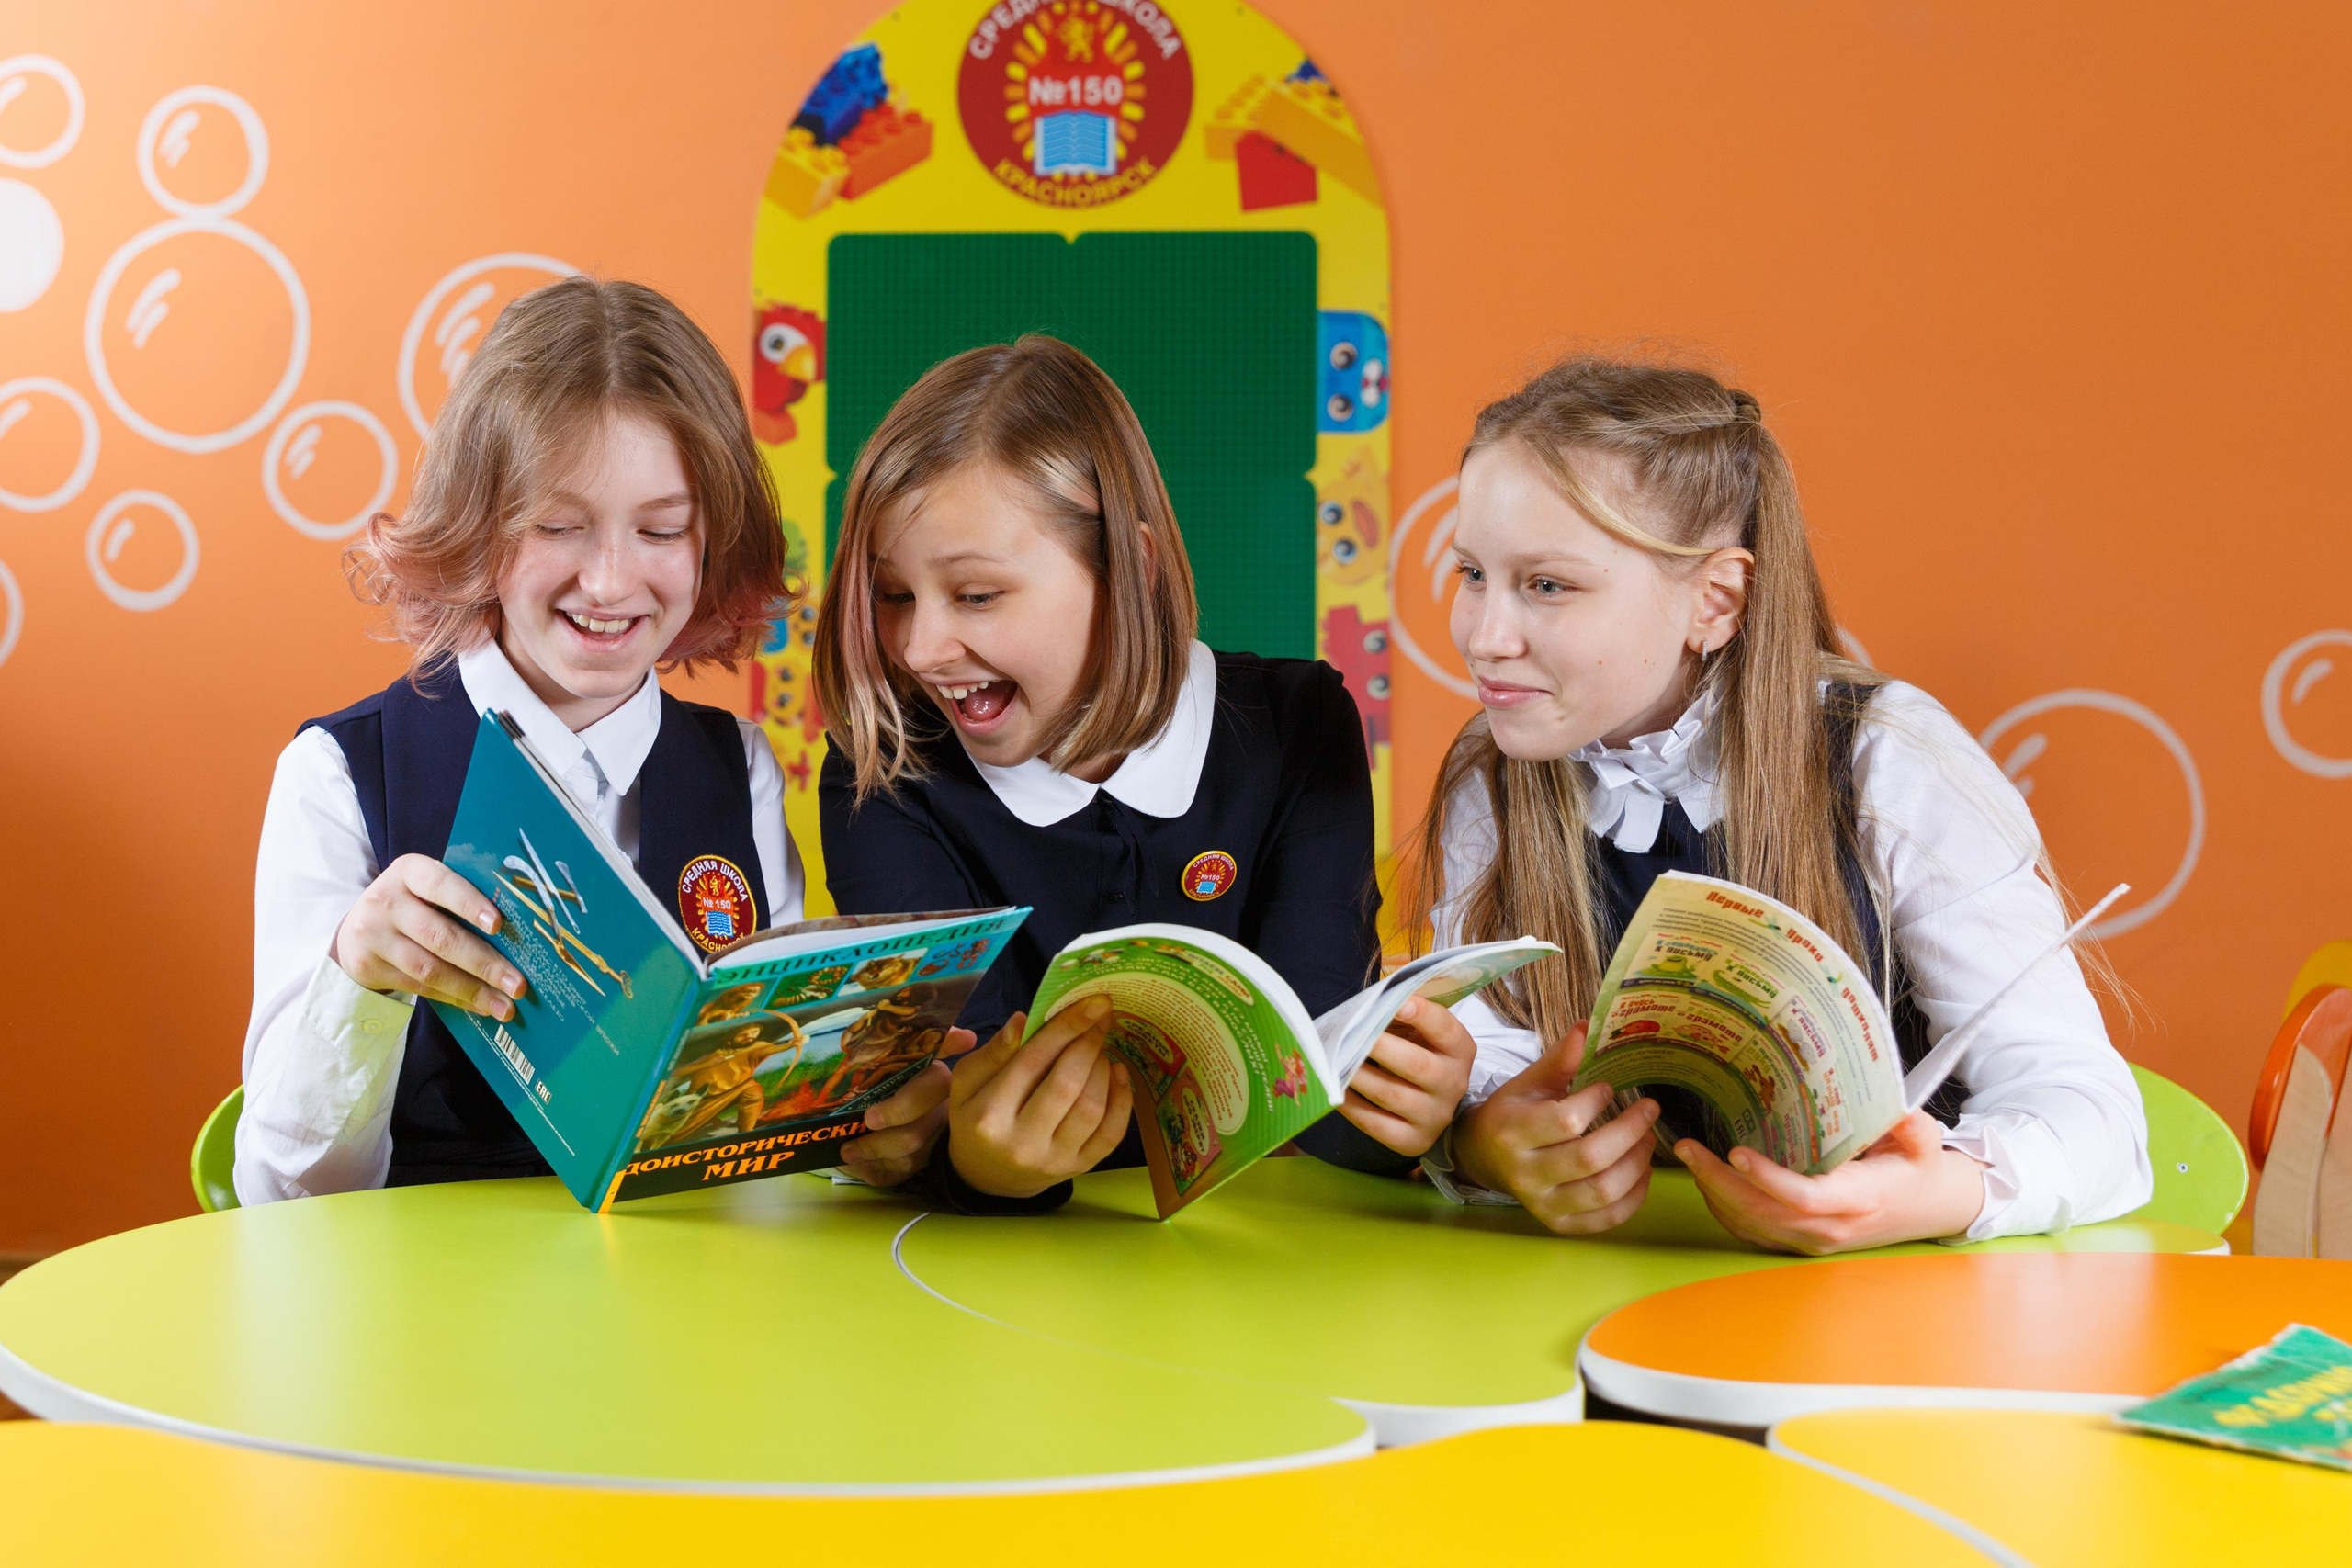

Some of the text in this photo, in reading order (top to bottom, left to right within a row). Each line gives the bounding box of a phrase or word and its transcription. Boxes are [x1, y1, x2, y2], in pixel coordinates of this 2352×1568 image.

[1027, 75, 1124, 106] №150
[994, 155, 1156, 209] КРАСНОЯРСК
[683, 860, 749, 902] СРЕДНЯЯ ШКОЛА
[716, 899, 731, 909] 150
[1706, 891, 1765, 919] Первые
[496, 931, 537, 986] РАГОЦЕННОЕ
[723, 919, 1003, 984] ЭНЦИКЛОПЕДИЯ
[1665, 945, 1713, 962] письму
[1736, 968, 1777, 999] письму
[1618, 1003, 1676, 1018] грамоте
[595, 1024, 619, 1056] ЭПОХИ
[1685, 1012, 1743, 1044] грамоте
[1795, 1016, 1826, 1058] письму
[624, 1121, 867, 1175] ДОИСТОРИЧЕСКИ
[701, 1151, 796, 1181] МИР
